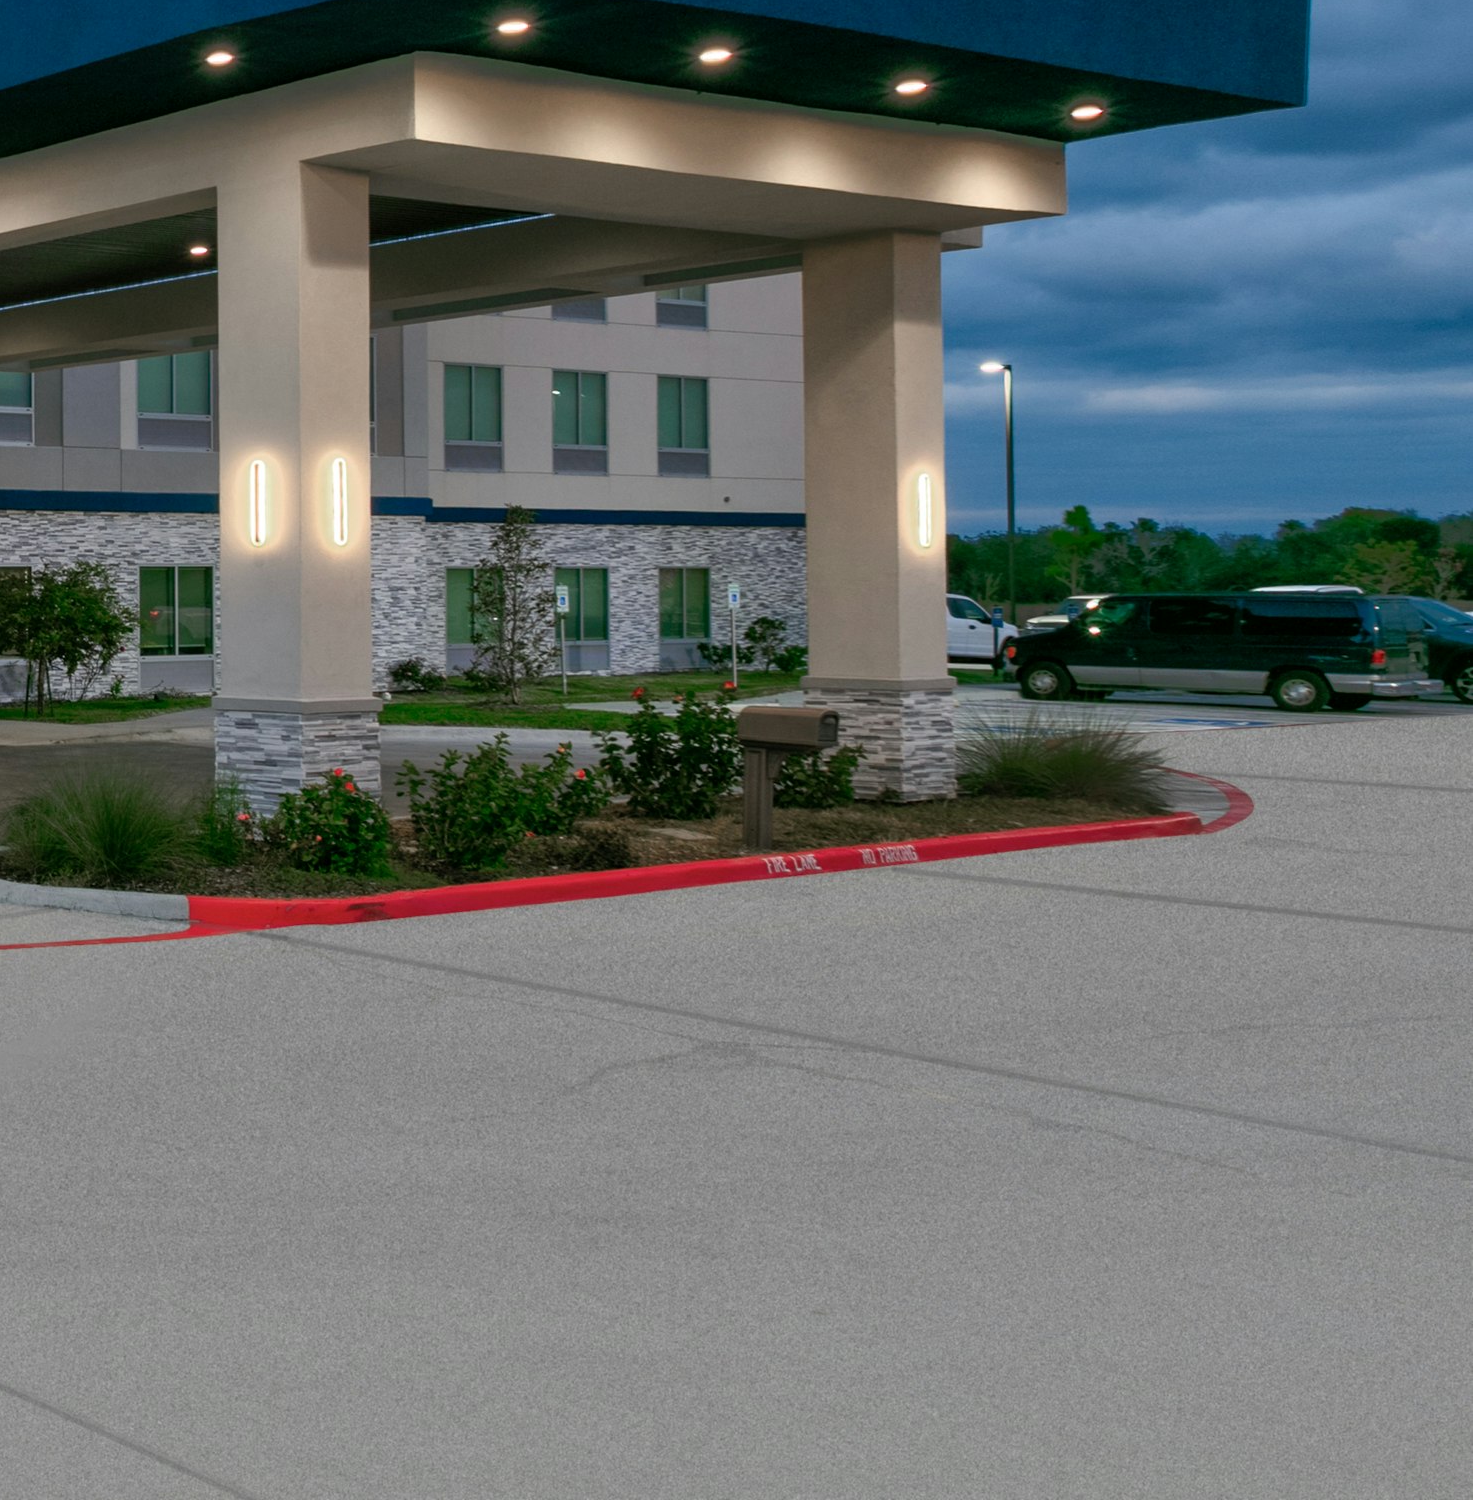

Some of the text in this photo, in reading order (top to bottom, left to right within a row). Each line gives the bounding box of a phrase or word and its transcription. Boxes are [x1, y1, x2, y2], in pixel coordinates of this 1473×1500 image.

[762, 853, 822, 874] FIRE LANE
[858, 844, 919, 865] NO PARKING
